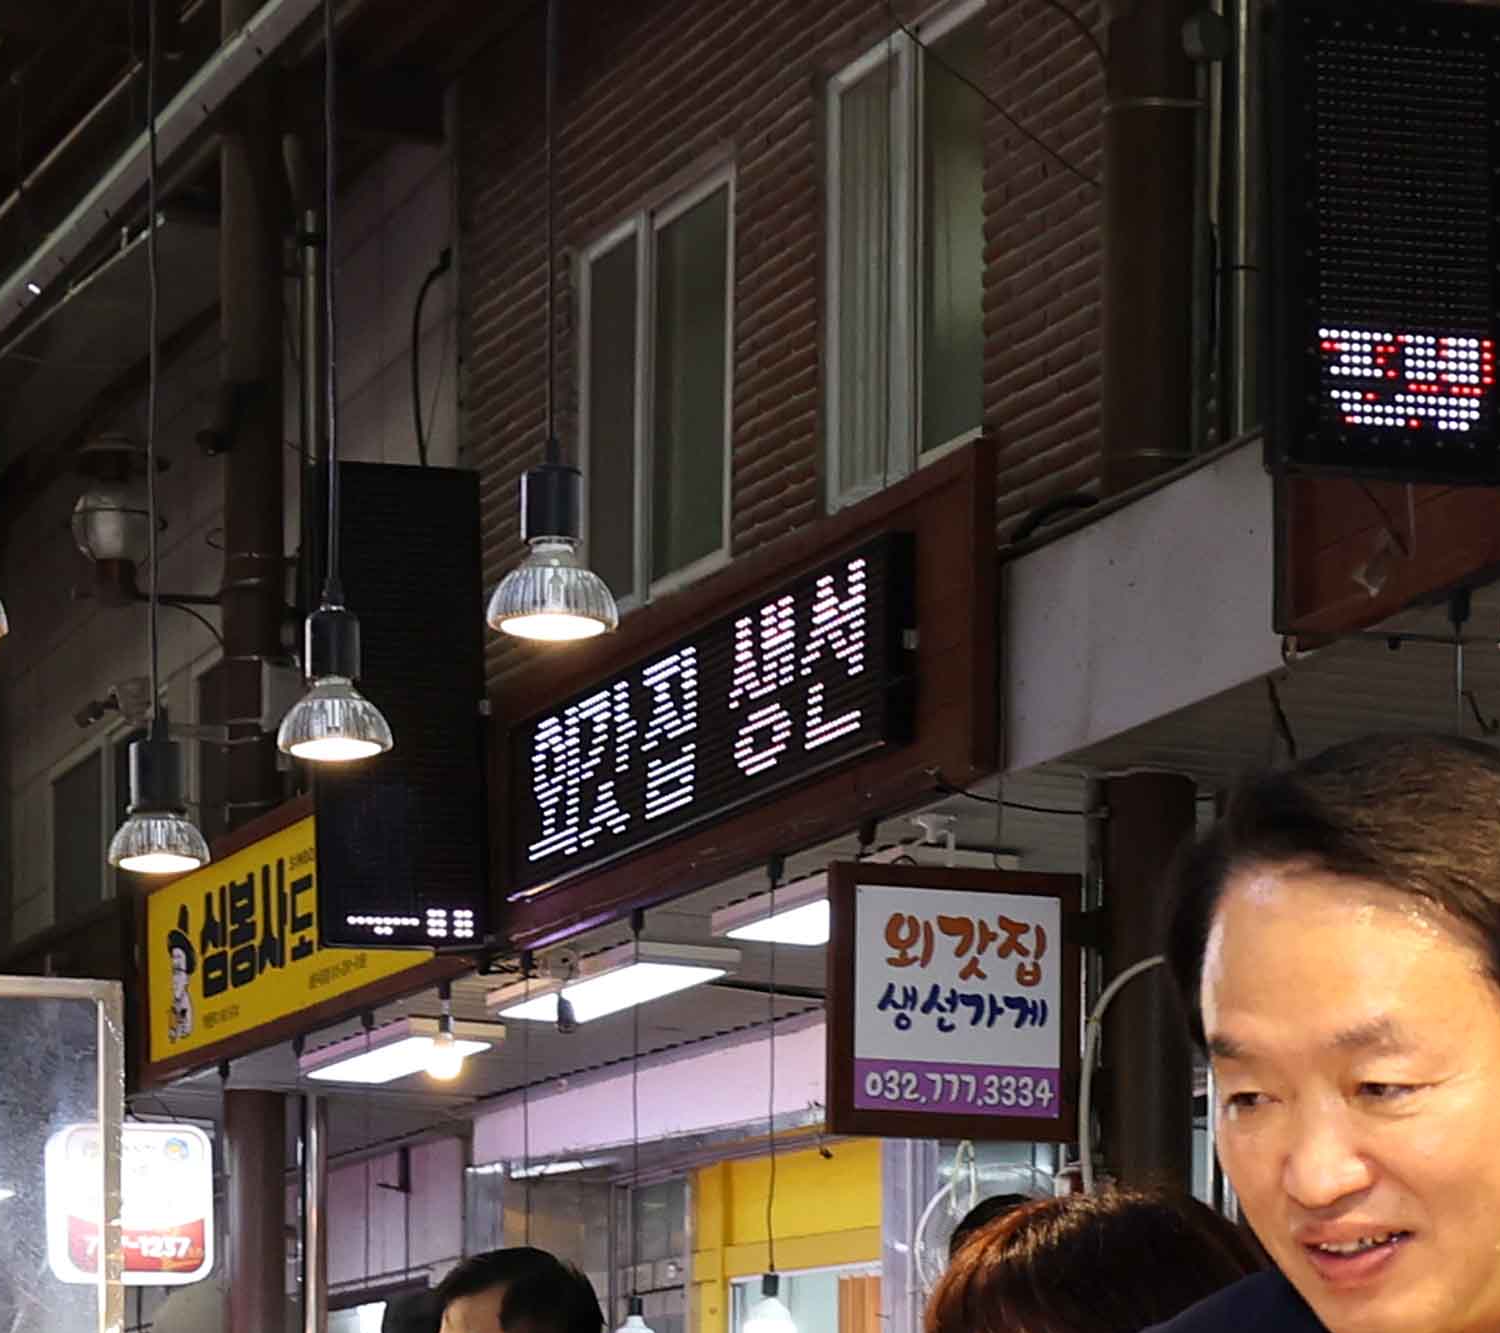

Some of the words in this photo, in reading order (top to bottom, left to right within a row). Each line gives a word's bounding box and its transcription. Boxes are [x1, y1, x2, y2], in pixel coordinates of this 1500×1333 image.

[728, 558, 867, 776] 생선
[884, 912, 1047, 988] 외갓집
[877, 982, 1048, 1033] 생선가게
[865, 1069, 1054, 1108] 032.777.3334
